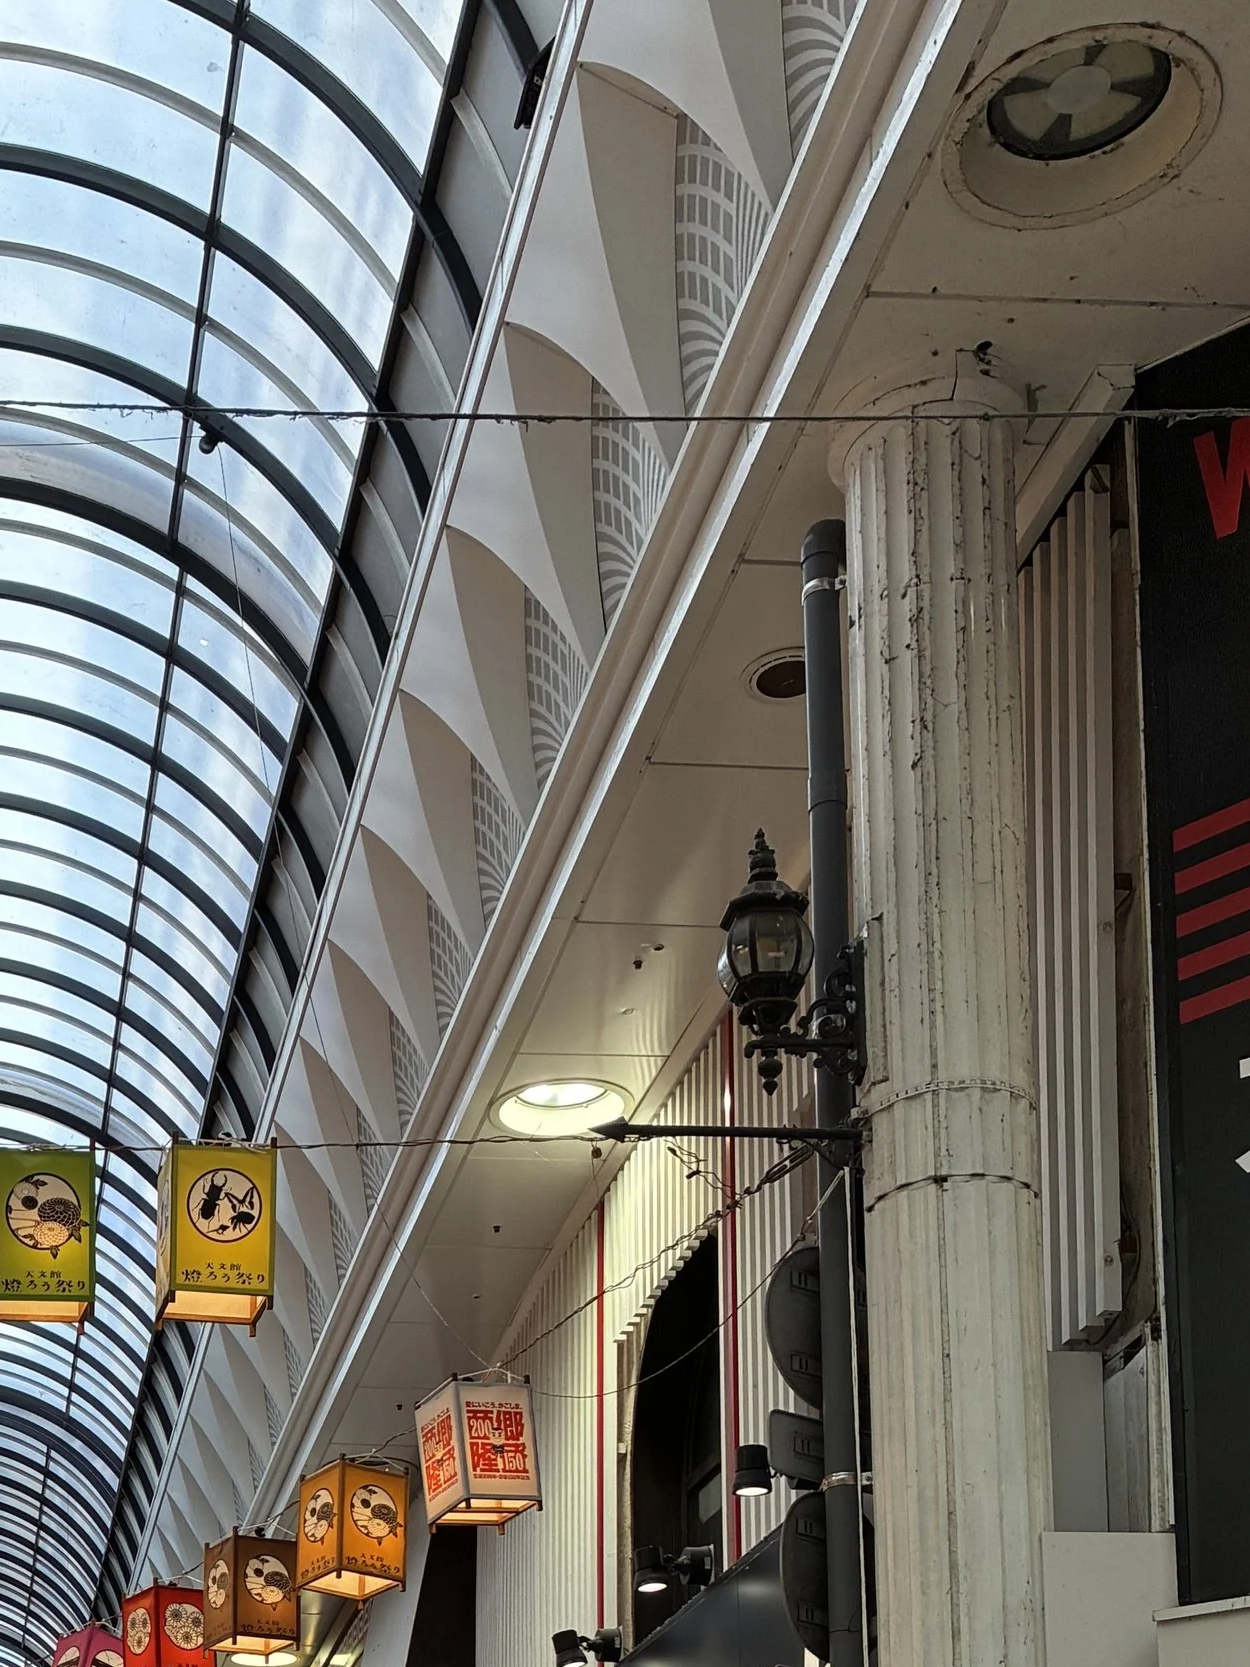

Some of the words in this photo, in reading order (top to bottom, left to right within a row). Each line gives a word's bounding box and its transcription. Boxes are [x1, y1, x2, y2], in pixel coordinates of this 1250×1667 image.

[205, 1262, 243, 1271] 天文館
[25, 1270, 63, 1279] 天文館
